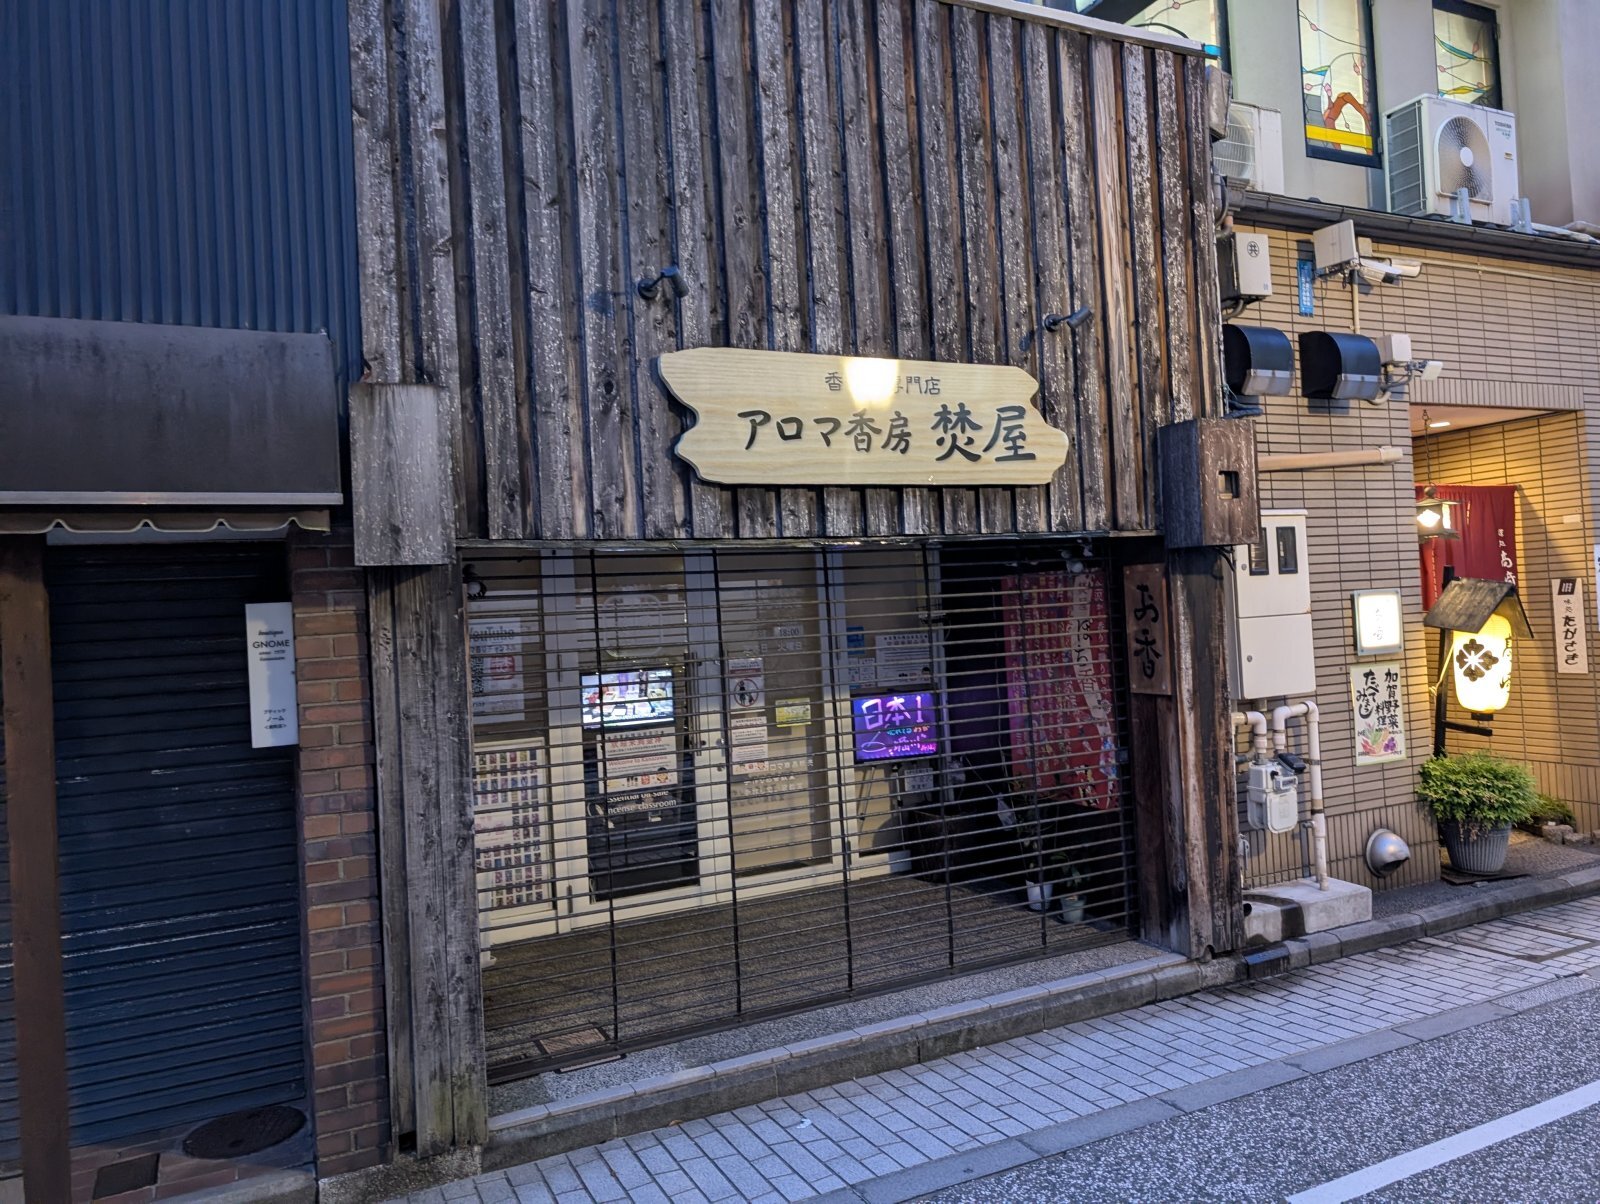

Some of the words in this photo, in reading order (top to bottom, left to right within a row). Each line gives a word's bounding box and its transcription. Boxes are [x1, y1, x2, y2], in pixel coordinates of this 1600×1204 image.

[737, 407, 912, 454] アロマ香房
[931, 402, 1036, 462] 焚屋
[252, 639, 290, 649] GNOME
[1134, 584, 1162, 679] お香
[1384, 669, 1399, 729] 加賀野菜
[1375, 700, 1387, 728] 料理
[607, 792, 640, 803] ssential
[608, 803, 634, 815] ncense
[638, 798, 677, 811] classroom
